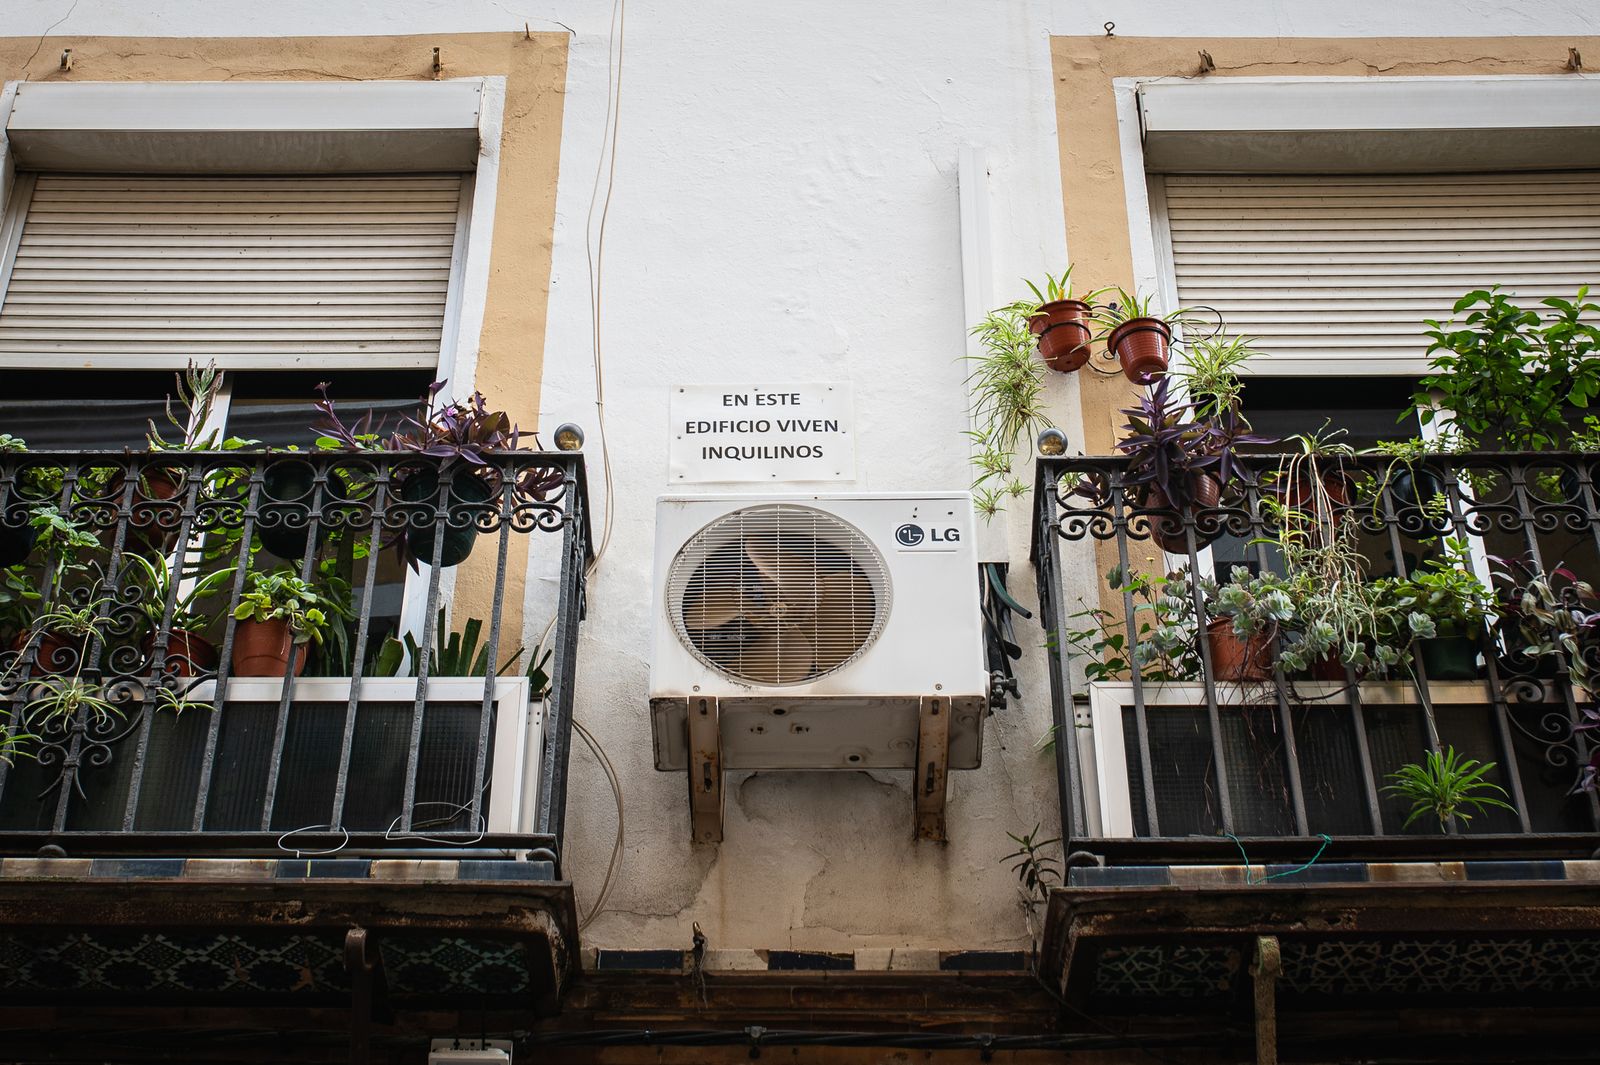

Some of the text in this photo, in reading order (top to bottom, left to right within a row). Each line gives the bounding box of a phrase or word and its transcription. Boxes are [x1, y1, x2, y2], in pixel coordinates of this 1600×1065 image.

[722, 393, 801, 407] EN ESTE
[685, 419, 839, 434] EDIFICIO VIVEN
[701, 445, 824, 461] INQUILINOS
[930, 528, 961, 543] LG
